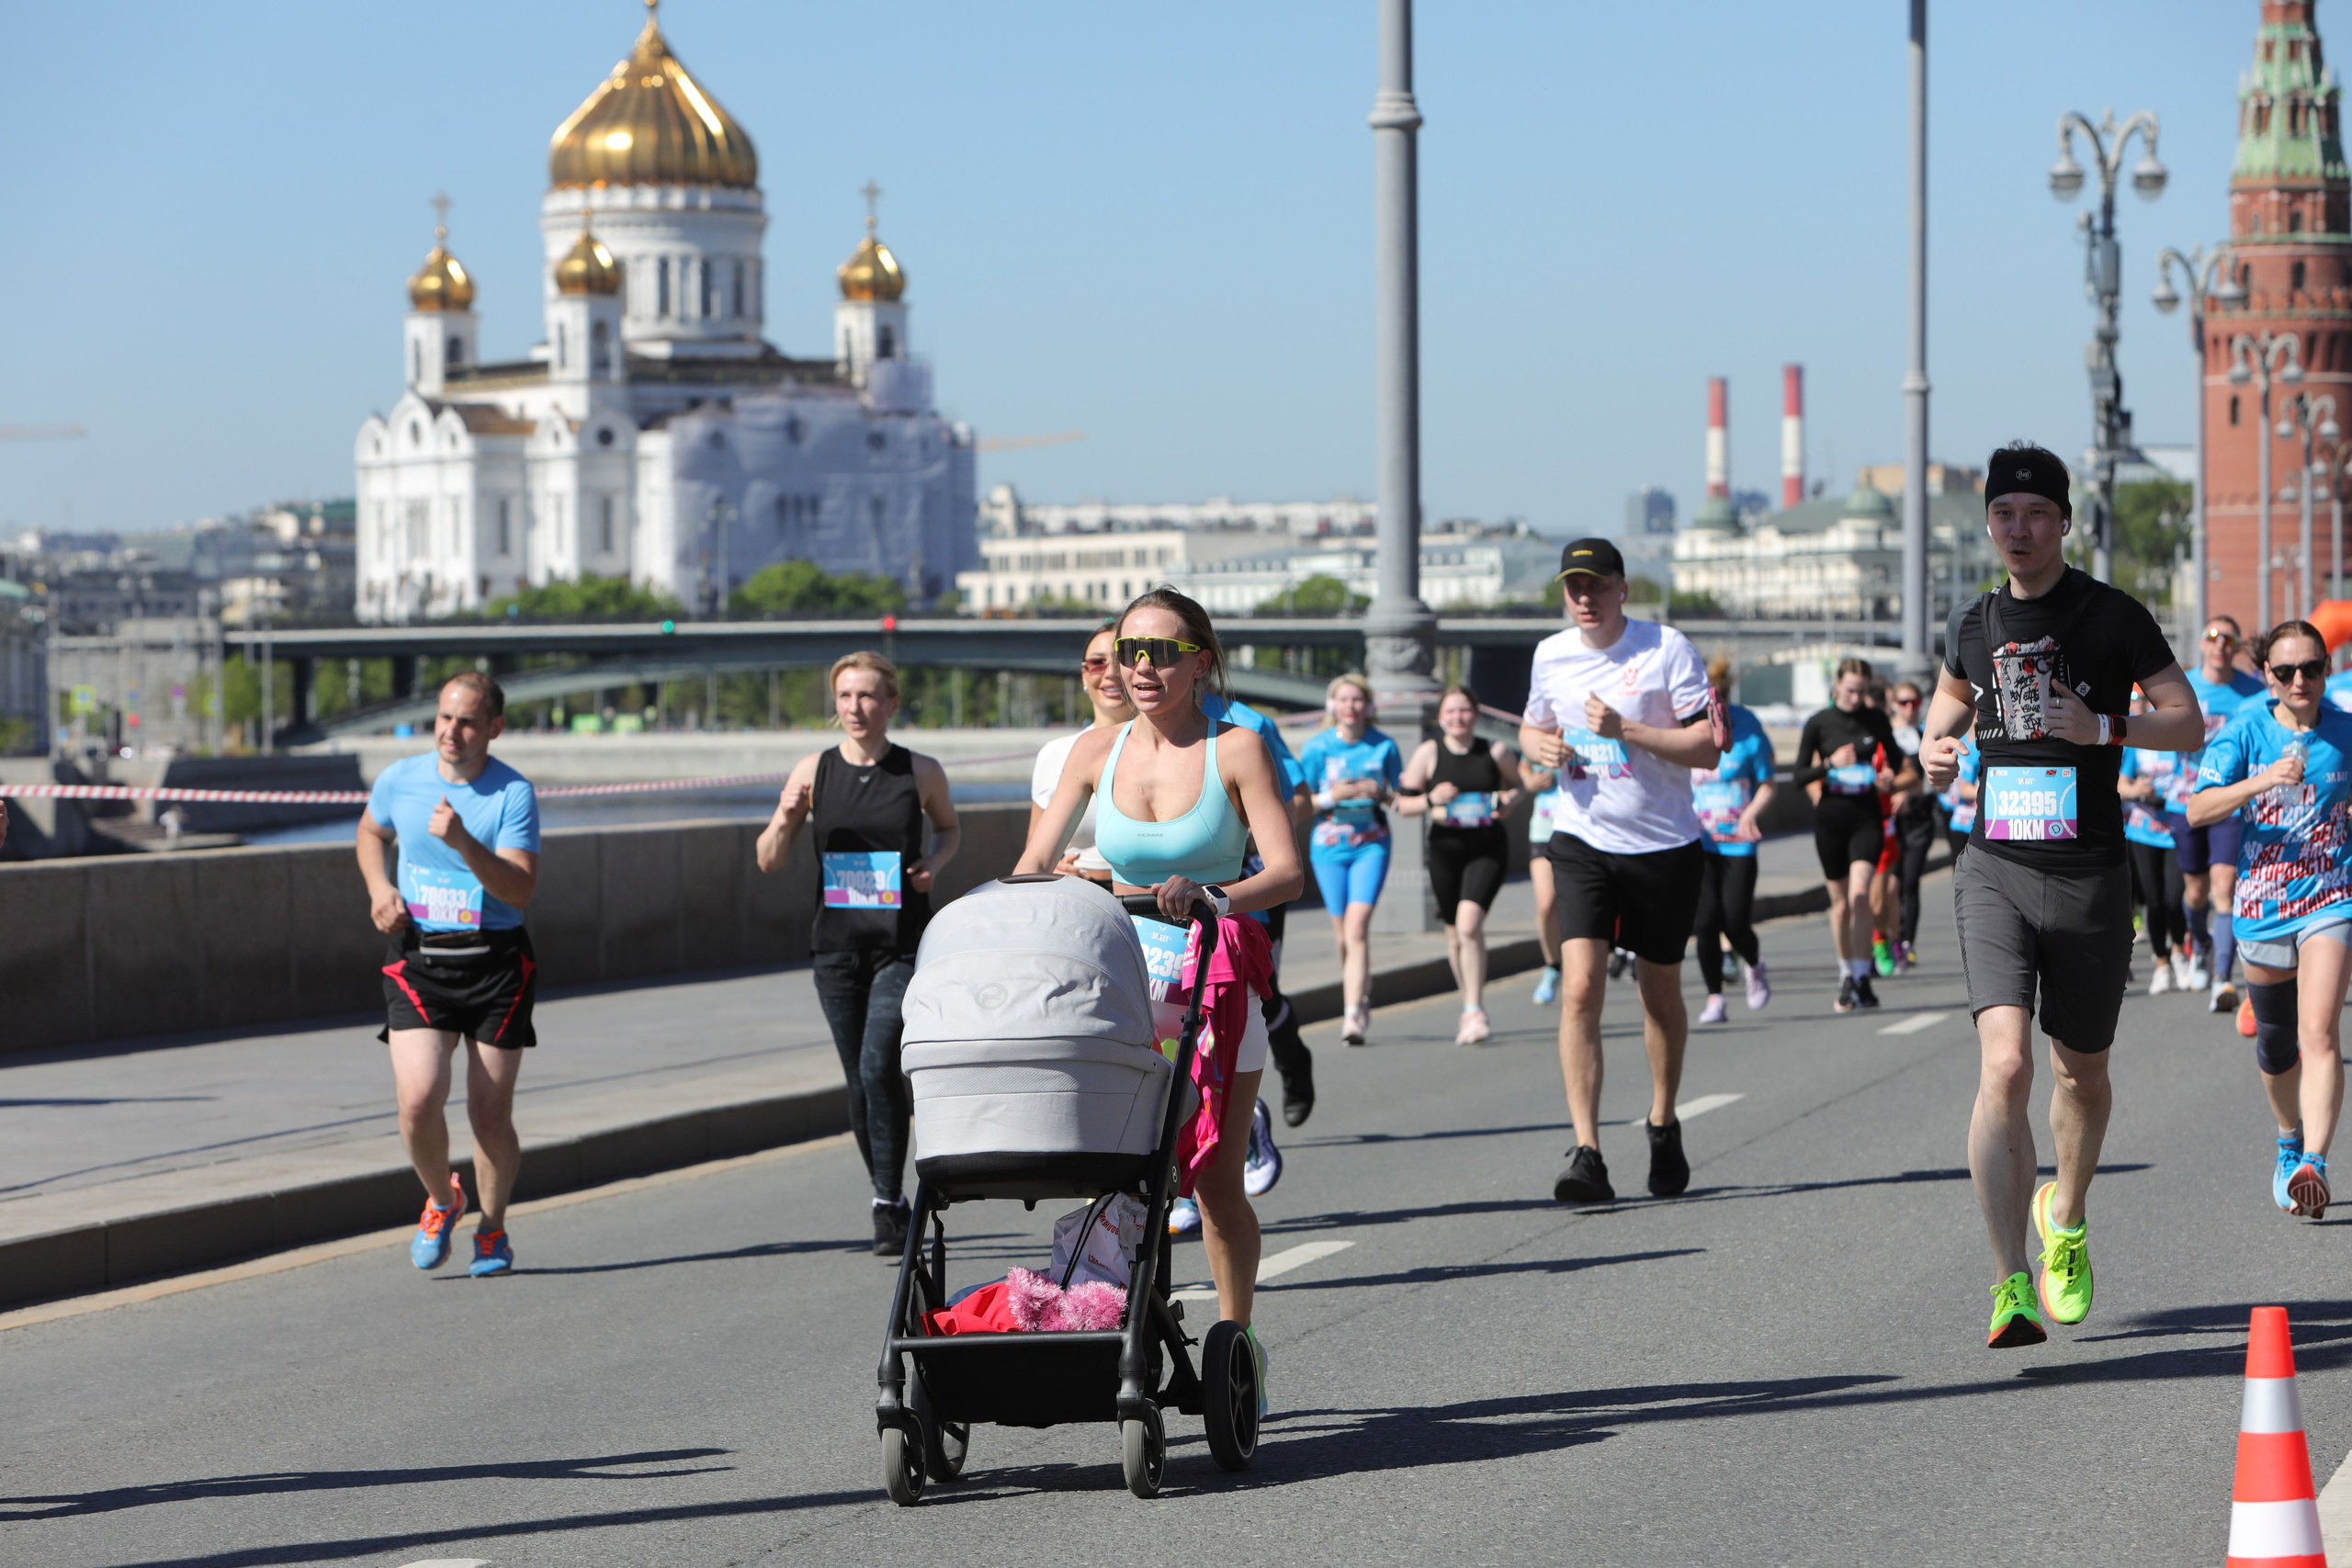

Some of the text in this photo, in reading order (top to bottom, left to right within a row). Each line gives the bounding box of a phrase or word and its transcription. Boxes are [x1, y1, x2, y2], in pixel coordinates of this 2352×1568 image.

[2198, 765, 2222, 784] ПСБ
[1997, 790, 2058, 817] 32395
[2007, 818, 2045, 840] 10KM
[2051, 824, 2062, 835] D
[836, 869, 887, 891] 70029
[419, 884, 468, 908] 70033
[1148, 976, 1170, 1003] KM
